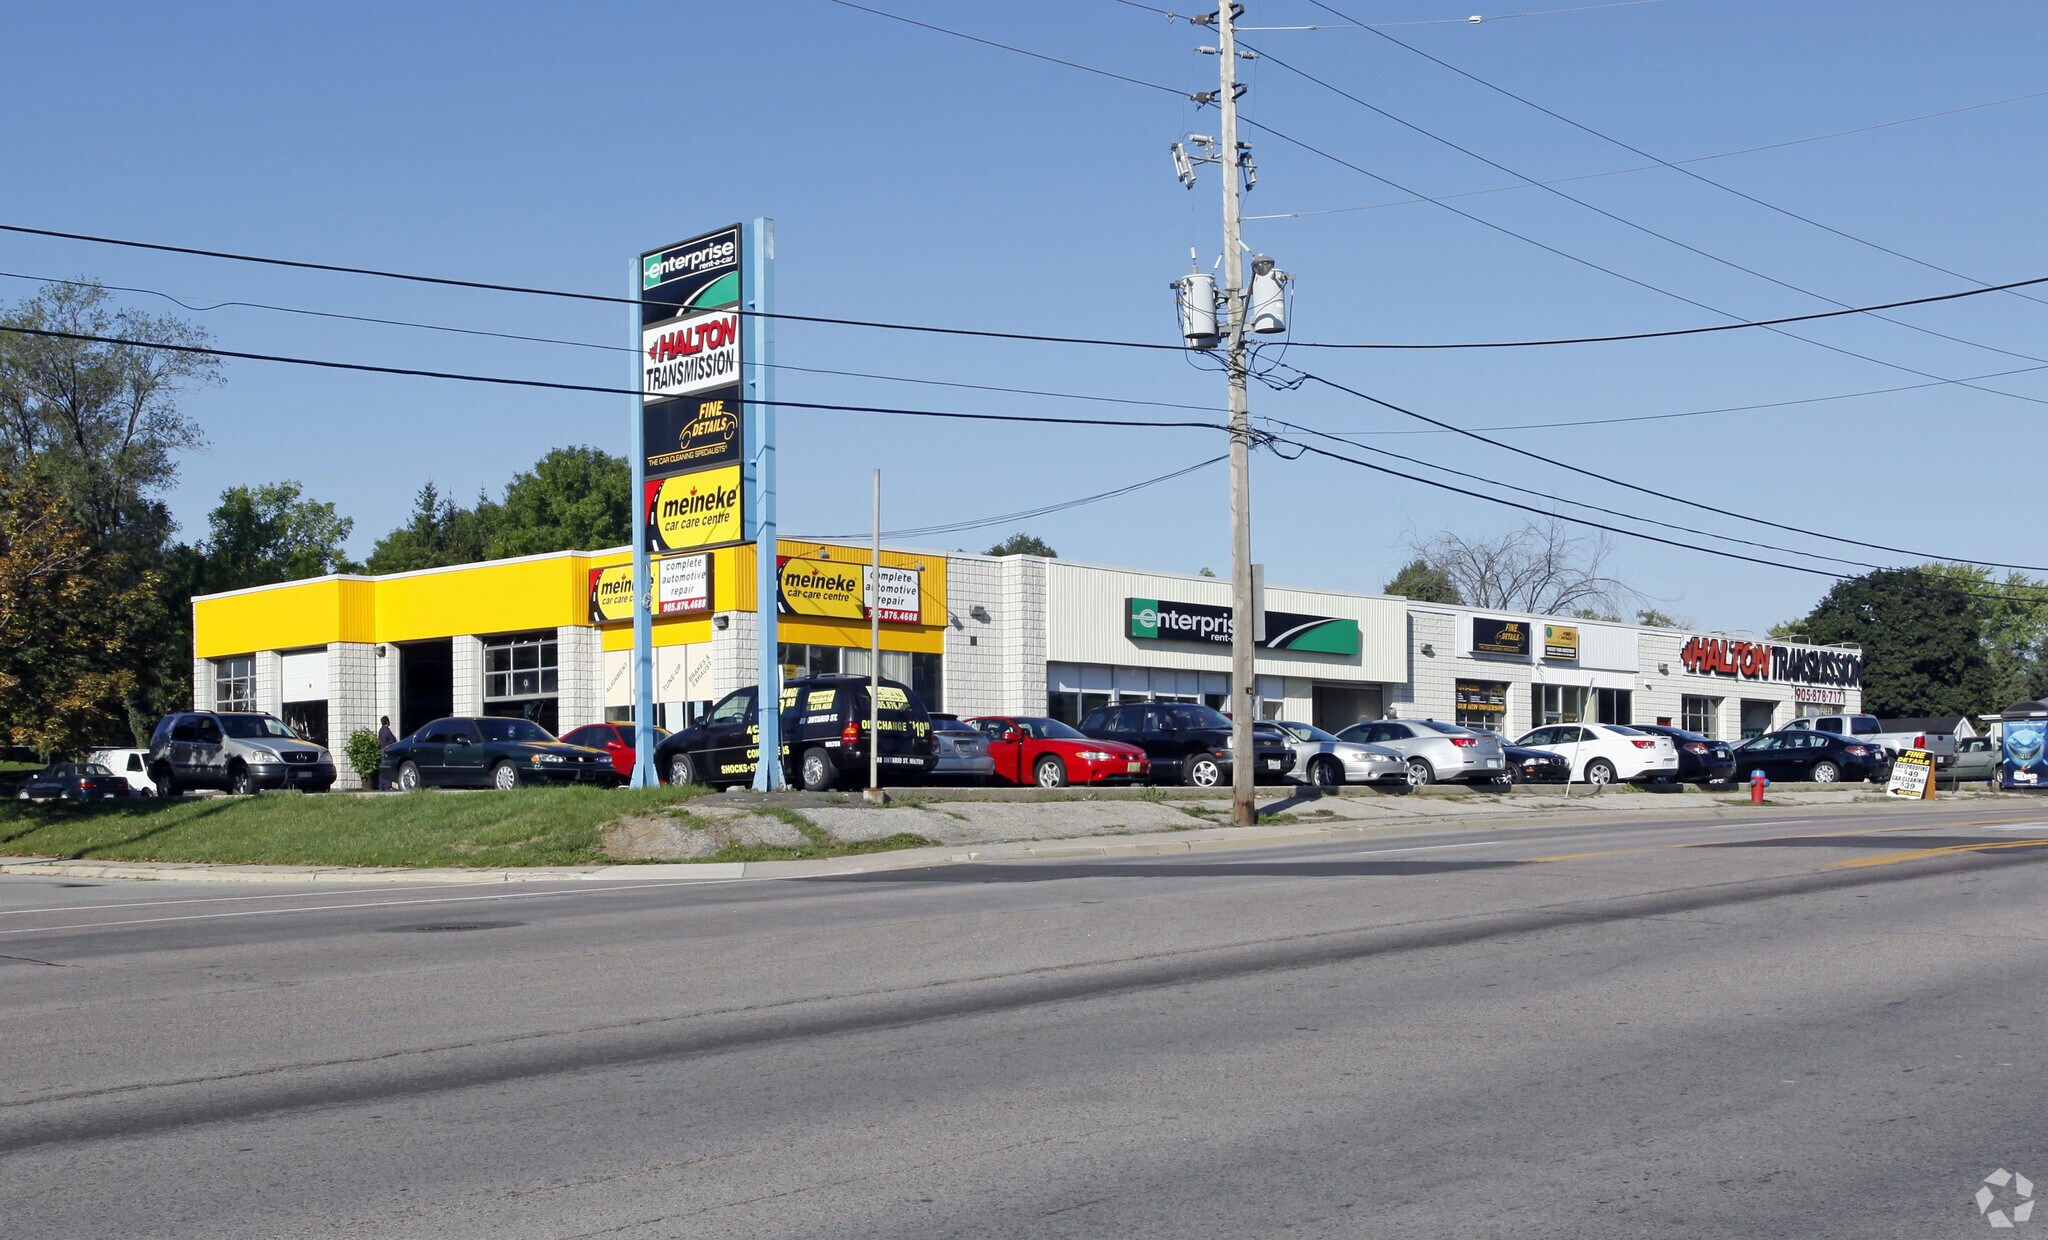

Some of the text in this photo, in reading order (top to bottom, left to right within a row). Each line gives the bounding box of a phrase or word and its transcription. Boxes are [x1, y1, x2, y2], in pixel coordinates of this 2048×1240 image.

[649, 241, 734, 278] enterprise
[699, 255, 733, 270] rent-a-car
[659, 315, 737, 362] HALTON
[646, 348, 734, 391] TRANSMISSION
[698, 400, 724, 420] FINE
[692, 417, 727, 437] DETAILS
[648, 445, 727, 467] THE CAR CLEANING SPECIALISTS
[663, 485, 737, 518] meineke
[664, 511, 730, 532] car care centre
[666, 558, 702, 571] complete
[661, 570, 706, 584] automotive
[785, 572, 856, 592] meineke
[870, 571, 912, 583] cmplete
[602, 597, 613, 605] car
[614, 595, 628, 604] care
[671, 584, 694, 597] repair
[787, 588, 849, 602] car care centre
[663, 599, 706, 612] 905.876.4688
[1501, 633, 1520, 641] DETAILS
[1505, 623, 1519, 632] FINE
[1690, 636, 1772, 680] HALTON
[1772, 646, 1864, 688] TRANSMISSION
[606, 662, 628, 693] ALIGNMENT
[662, 663, 682, 692] TUNE-UP
[688, 657, 706, 683] BRAKES
[692, 661, 712, 687] EXHAUST
[877, 721, 907, 731] CHANGE
[1897, 757, 1930, 765] DETAILS
[1905, 750, 1926, 758] FINE
